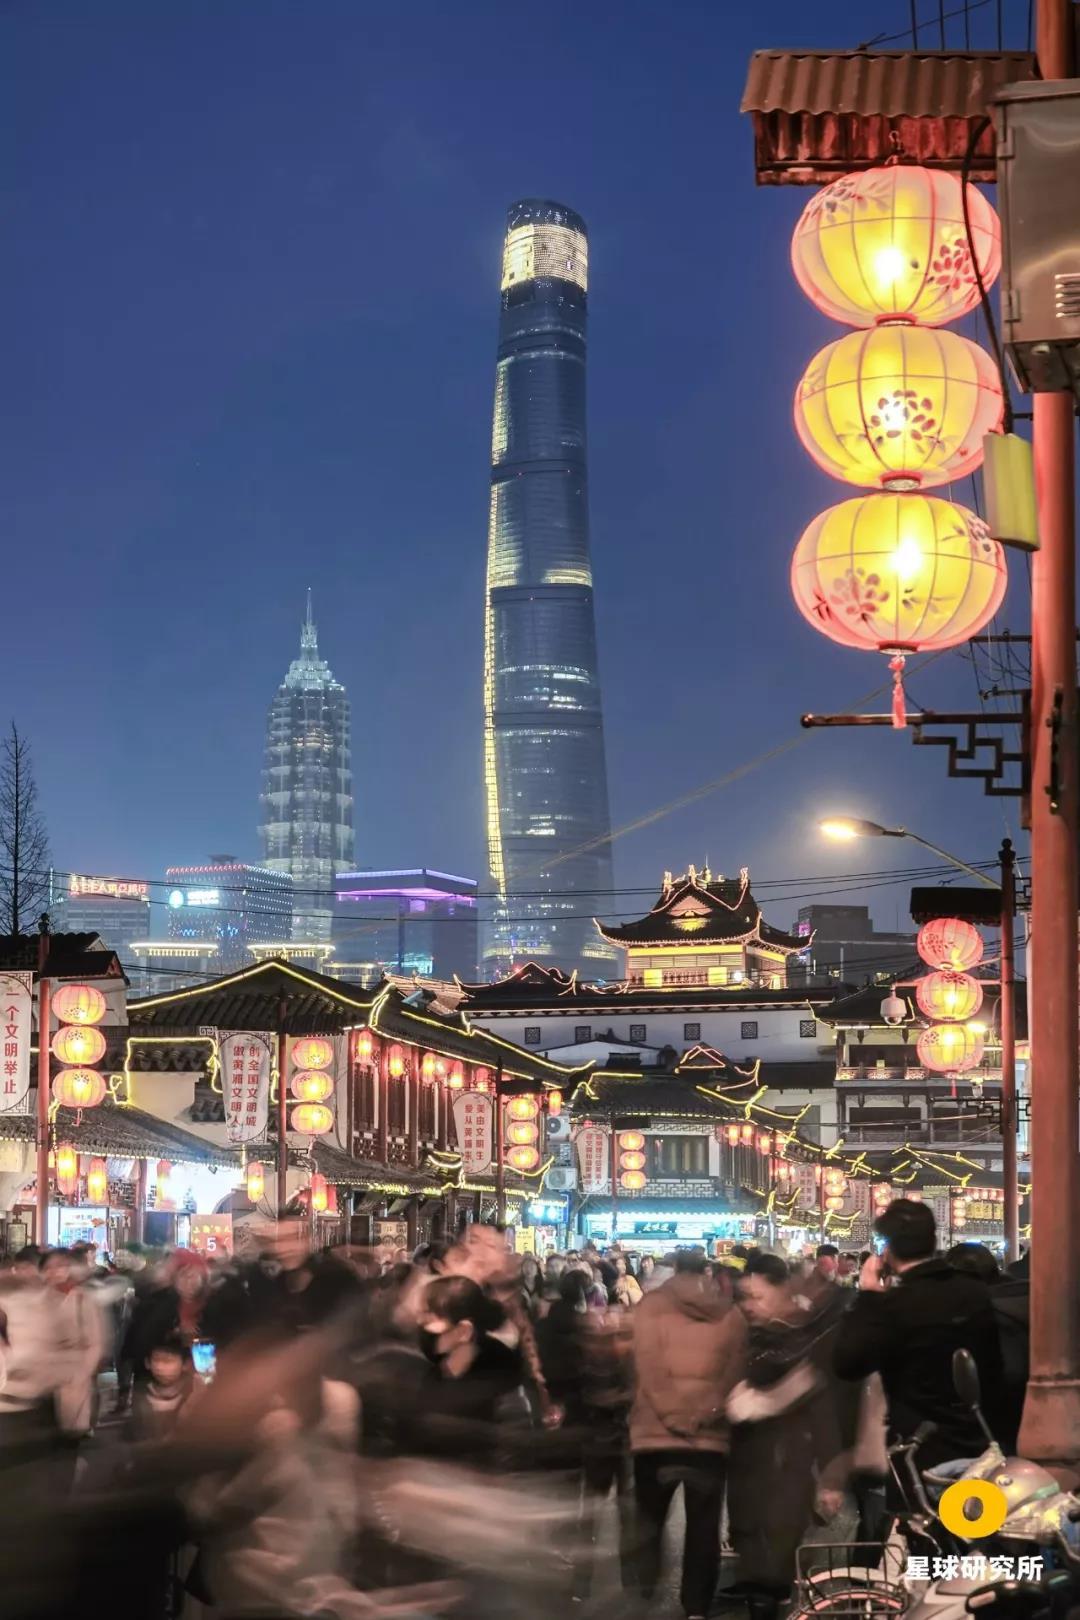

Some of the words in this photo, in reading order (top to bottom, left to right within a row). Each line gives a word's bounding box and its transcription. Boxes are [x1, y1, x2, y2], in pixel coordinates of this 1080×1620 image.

[3, 992, 20, 1095] 一个文明举止
[245, 1046, 260, 1127] 创全国文明城
